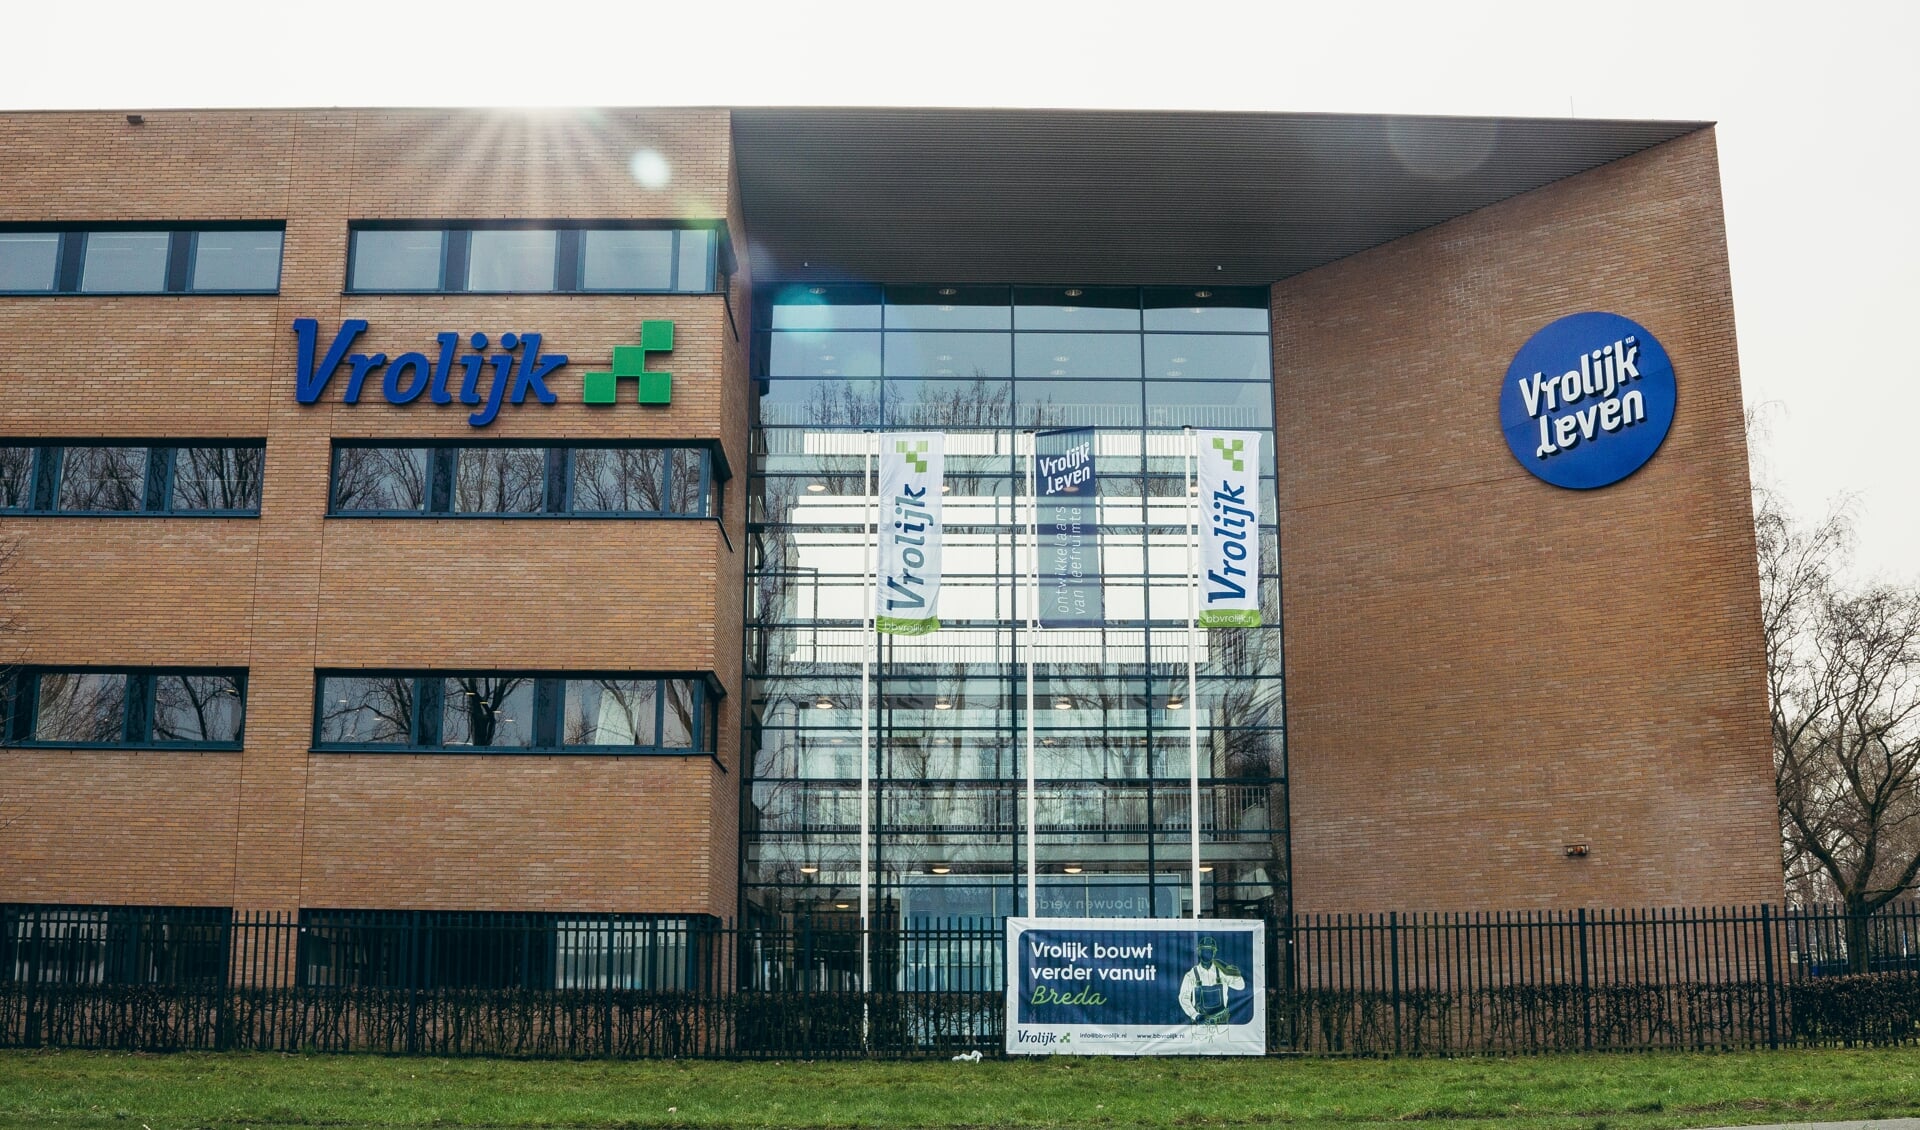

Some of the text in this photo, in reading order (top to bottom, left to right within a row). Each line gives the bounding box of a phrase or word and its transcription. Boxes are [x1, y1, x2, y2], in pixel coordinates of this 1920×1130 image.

[293, 318, 568, 427] Vrolijk
[1518, 340, 1641, 418] Vrolijk
[1536, 390, 1645, 458] Leven
[1040, 444, 1090, 477] Vrolijk
[886, 483, 934, 610] Vrolijk
[1055, 506, 1069, 613] ontwikkelaars
[1069, 507, 1085, 615] van leefruimte
[1208, 480, 1255, 603] Vrolijk
[1206, 614, 1254, 624] bbvrolijk.n
[1031, 941, 1153, 962] Vrolijk bouwt
[1031, 964, 1157, 981] verder vanuit
[1030, 985, 1107, 1006] Breda
[1017, 1030, 1057, 1046] Vrolijk
